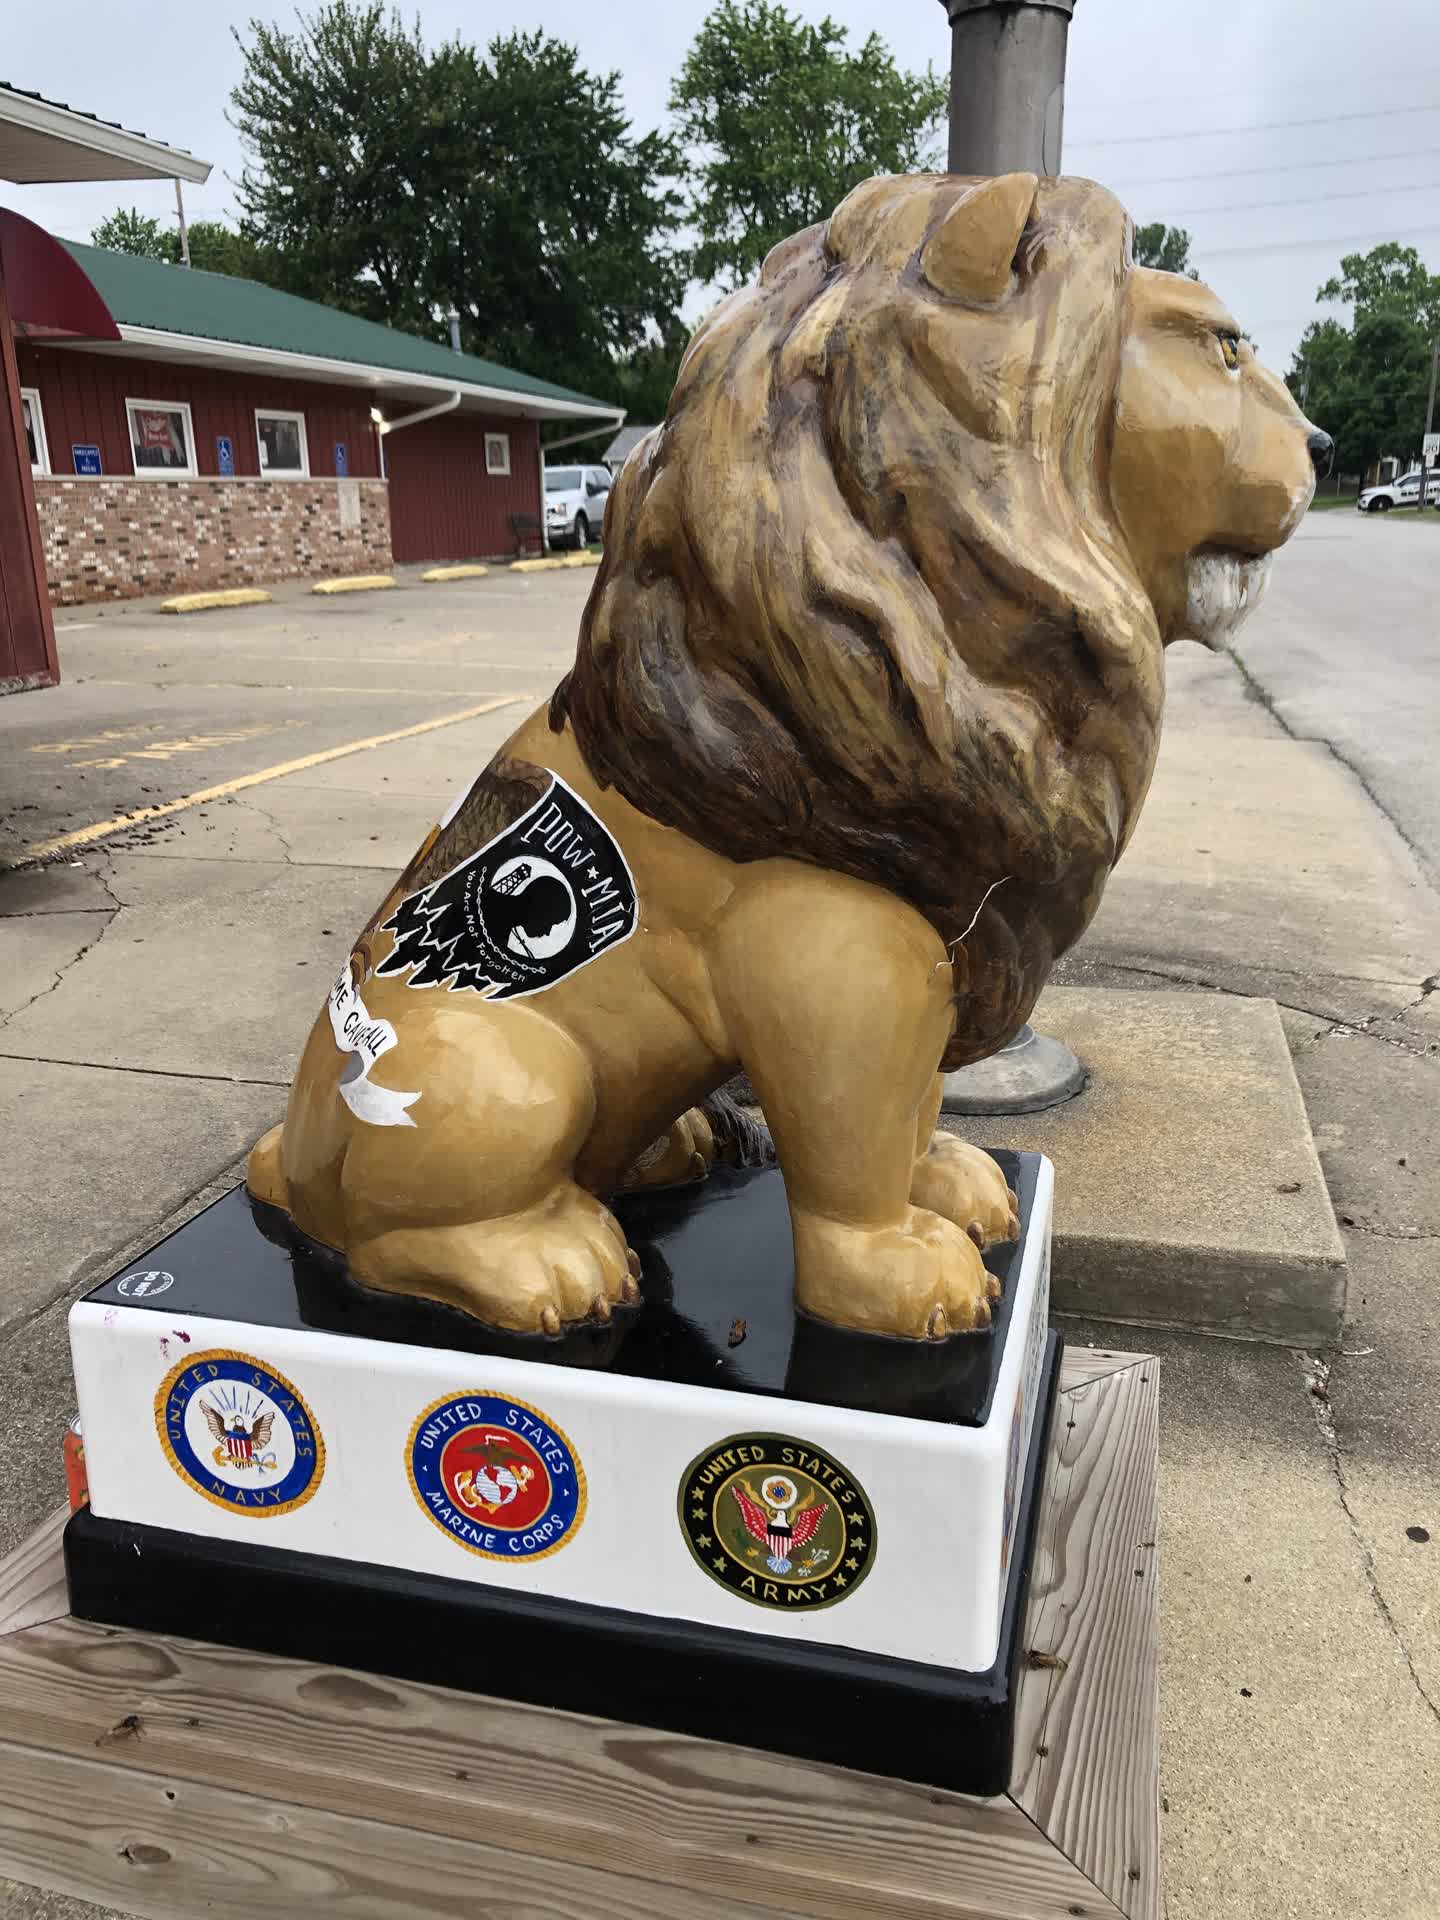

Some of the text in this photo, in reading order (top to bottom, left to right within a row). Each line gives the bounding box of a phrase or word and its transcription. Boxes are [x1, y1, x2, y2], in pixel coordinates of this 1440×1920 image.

[466, 870, 477, 888] You
[520, 801, 625, 953] POW MIA
[464, 892, 472, 912] Are
[466, 915, 479, 938] Not
[171, 1364, 313, 1457] UNITED STATES
[420, 1403, 569, 1474] UNITED STATES
[212, 1481, 281, 1505] NAVY
[699, 1445, 857, 1504] UNITED STATES
[426, 1491, 564, 1552] MARINE CORPS
[740, 1575, 827, 1602] ARMY
